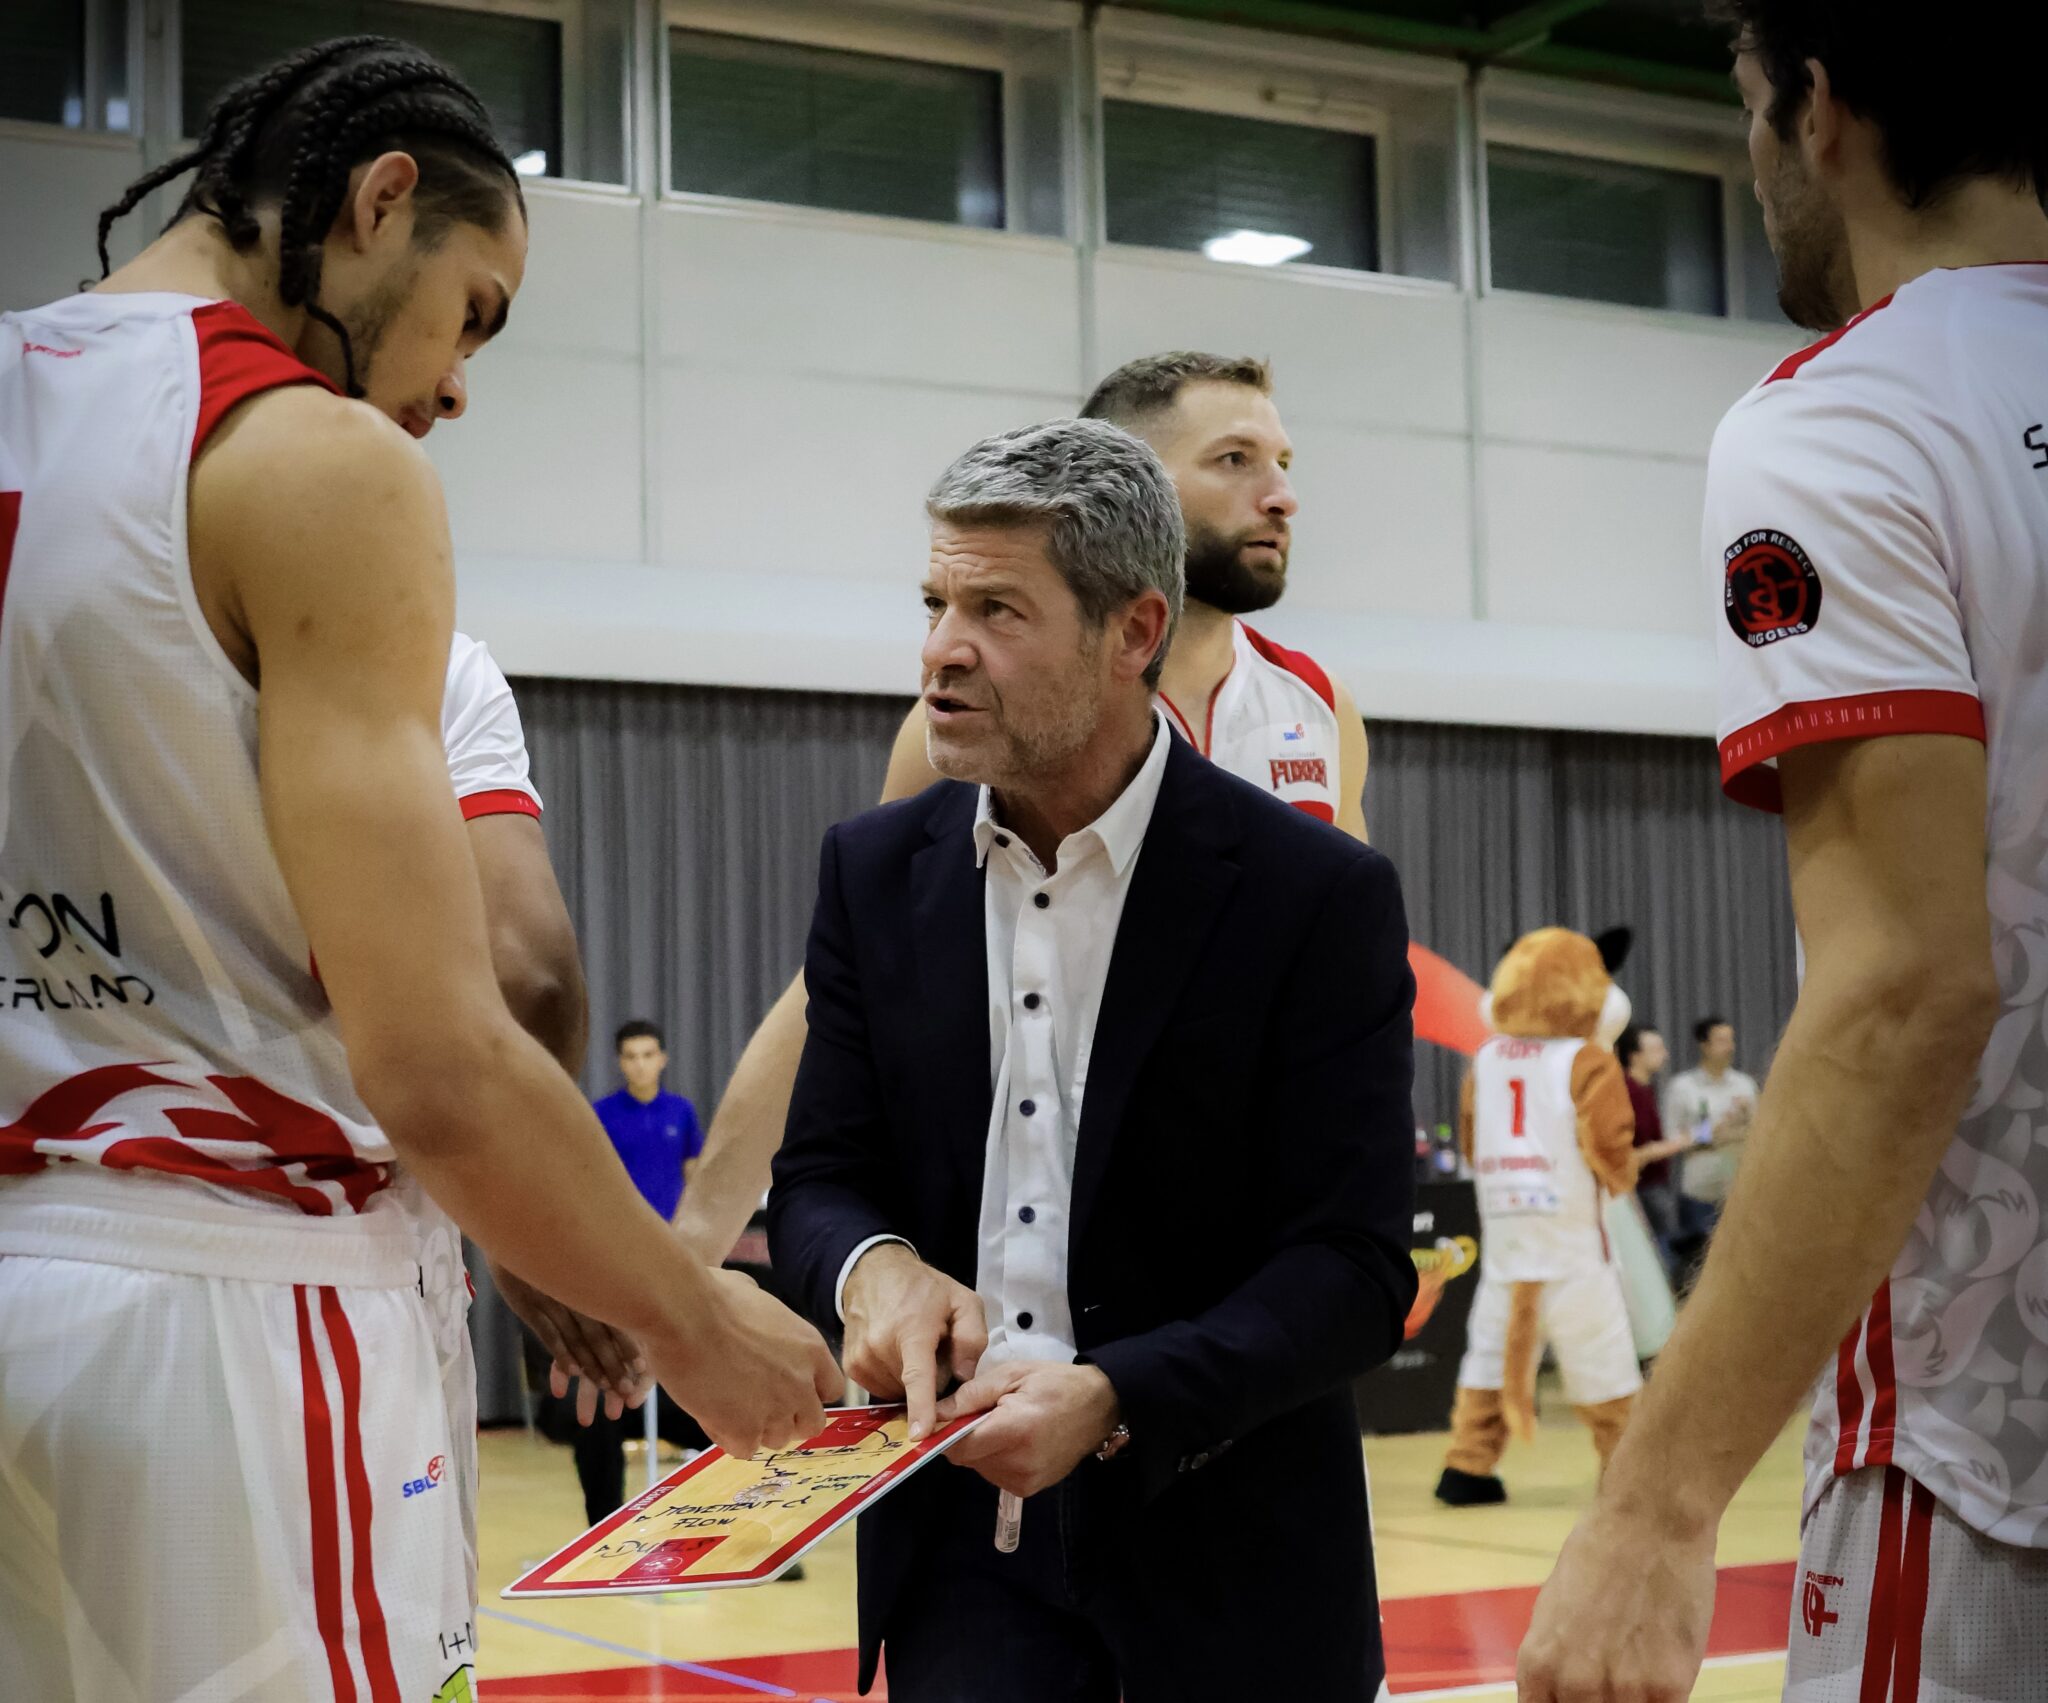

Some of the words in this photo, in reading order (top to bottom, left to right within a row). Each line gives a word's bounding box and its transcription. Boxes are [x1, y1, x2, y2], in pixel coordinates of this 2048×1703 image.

[1744, 532, 1767, 547] FOR
[1770, 533, 1815, 578] RESPECT
[1509, 1078, 1525, 1137] 1
[403, 1476, 438, 1498] SBL
[655, 1499, 783, 1518] MOVEMENT
[672, 1517, 737, 1529] FLOW
